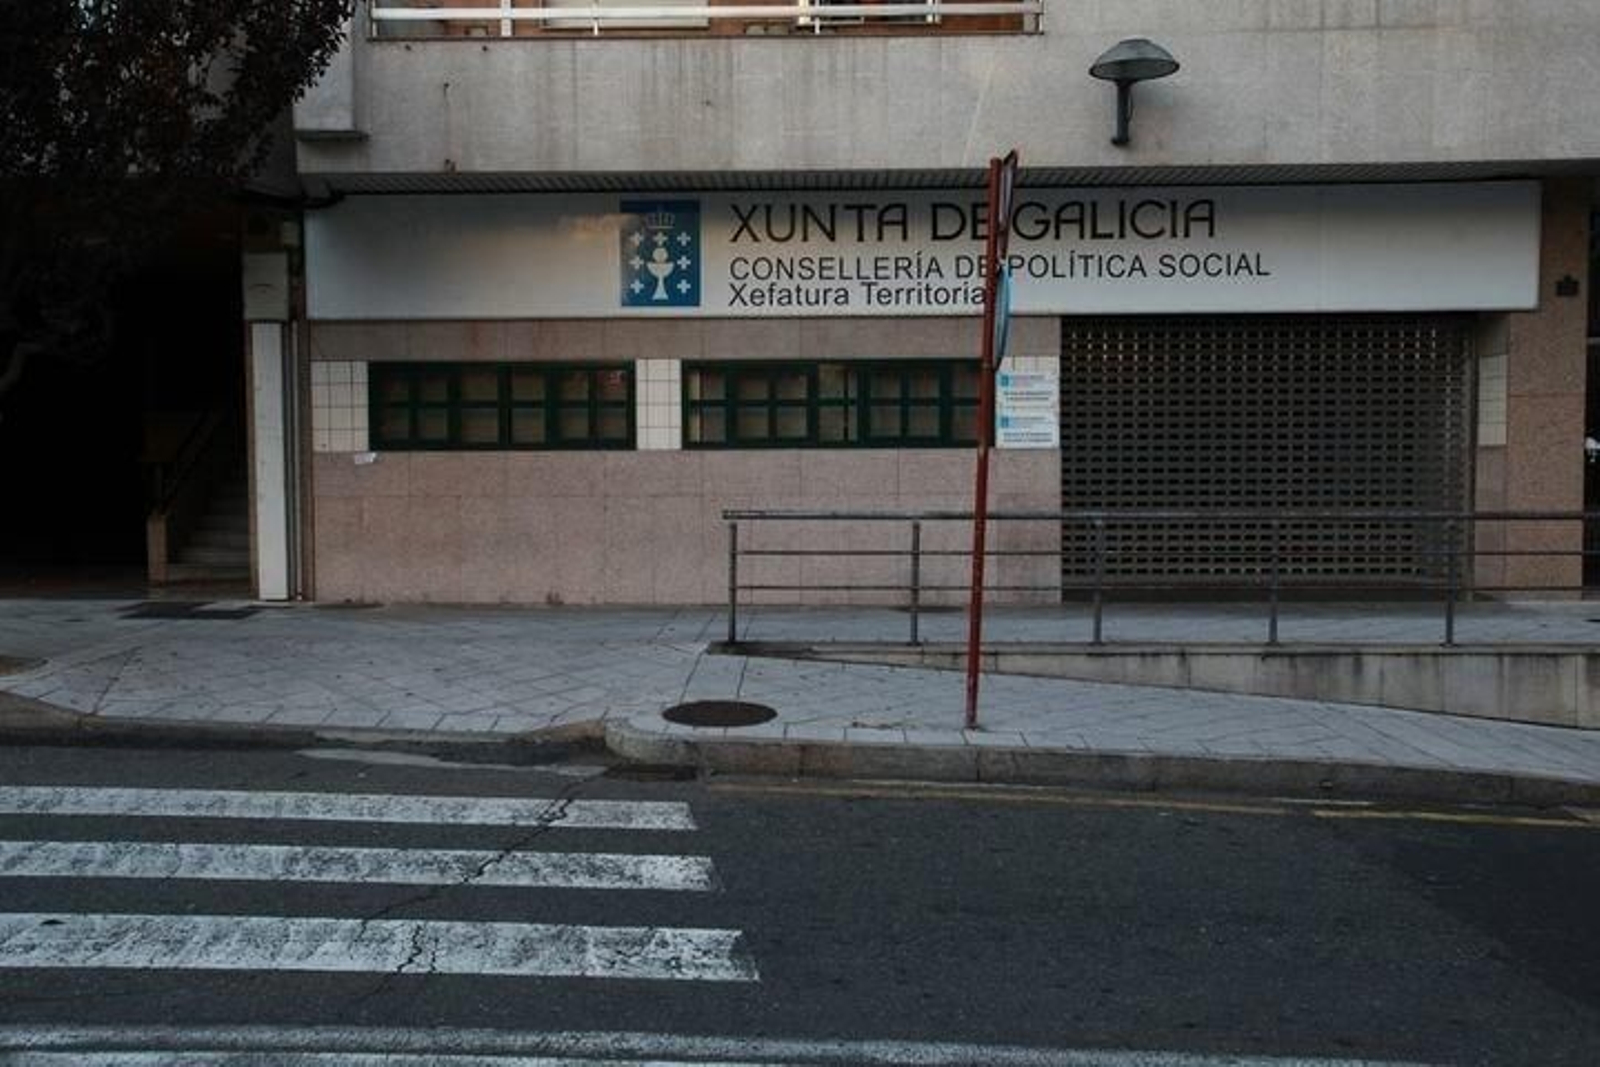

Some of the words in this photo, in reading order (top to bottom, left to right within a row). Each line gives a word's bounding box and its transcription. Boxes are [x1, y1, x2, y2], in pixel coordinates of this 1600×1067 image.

[729, 203, 908, 242] XUNTA
[931, 202, 989, 241] DE
[1012, 198, 1215, 240] GALICIA
[730, 252, 943, 280] CONSELLERÍA
[955, 254, 988, 278] DE
[1008, 250, 1147, 279] POLÍTICA
[1159, 252, 1271, 277] SOCIAL
[728, 282, 850, 306] Xefatura
[860, 281, 987, 306] Territoria
